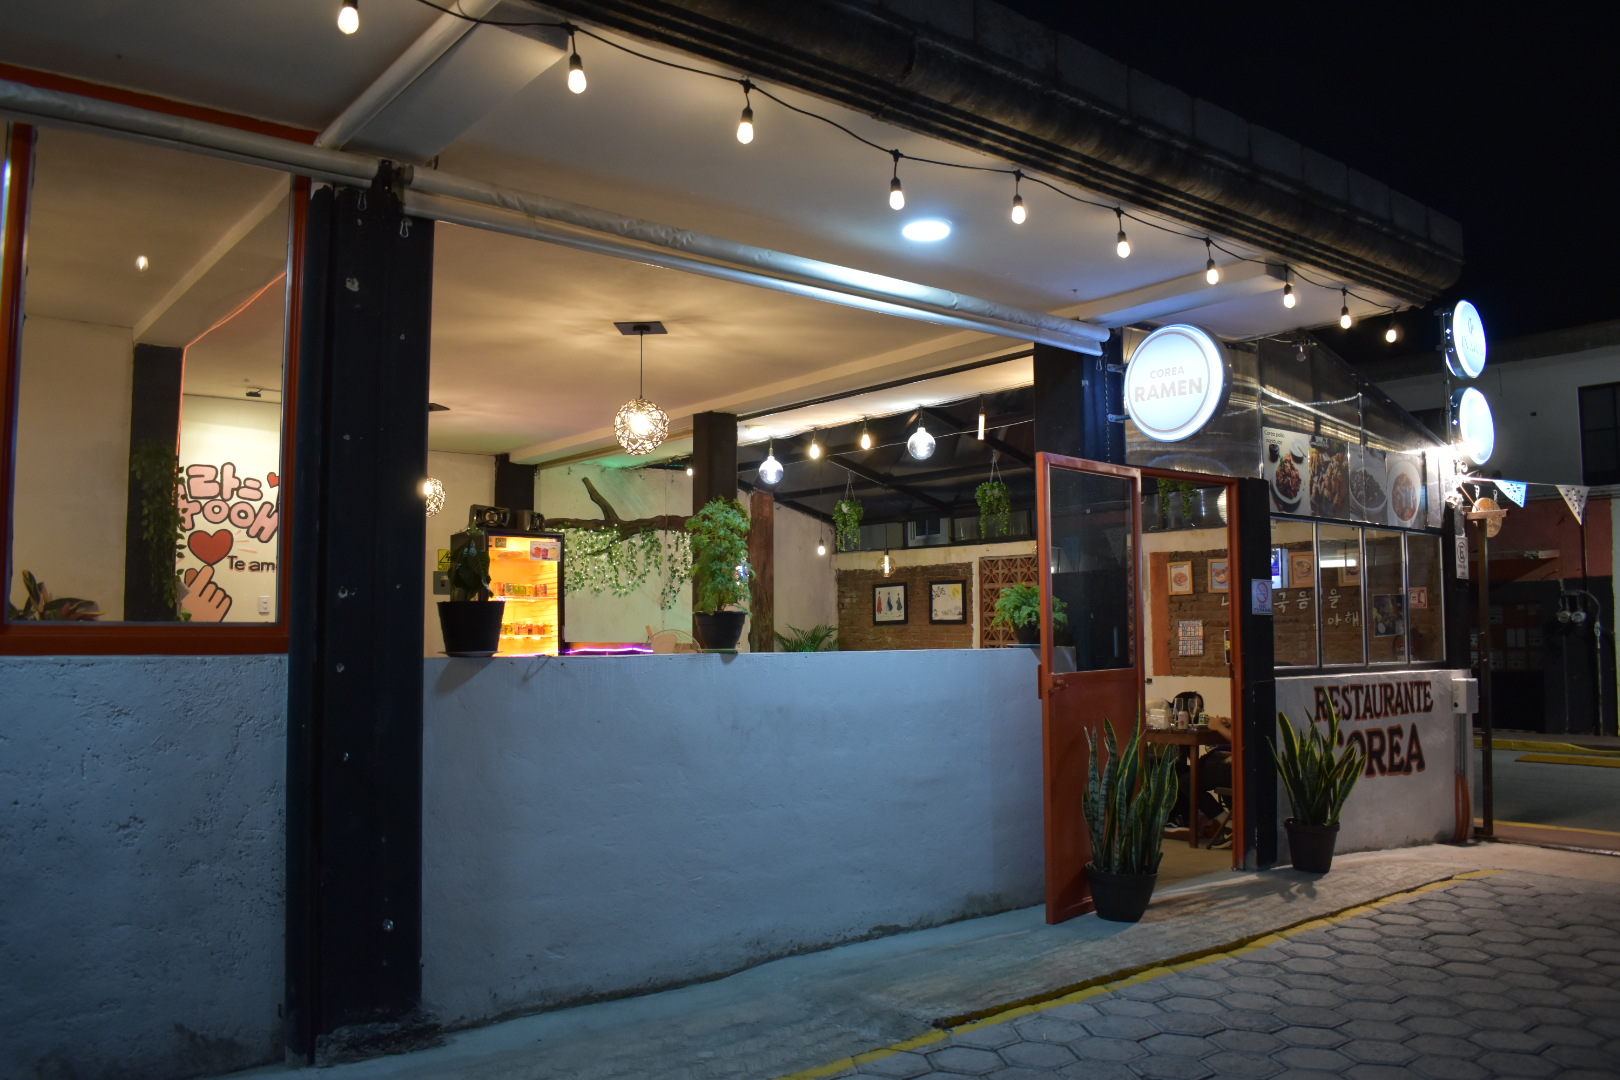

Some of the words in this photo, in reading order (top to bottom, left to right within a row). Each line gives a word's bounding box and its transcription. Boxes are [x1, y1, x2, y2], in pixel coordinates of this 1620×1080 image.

[1150, 366, 1184, 379] COREA
[1134, 377, 1203, 402] RAMEN
[227, 555, 245, 571] Te
[249, 560, 277, 572] am
[1313, 680, 1434, 722] RESTAURANTE
[1332, 722, 1426, 779] OREA
